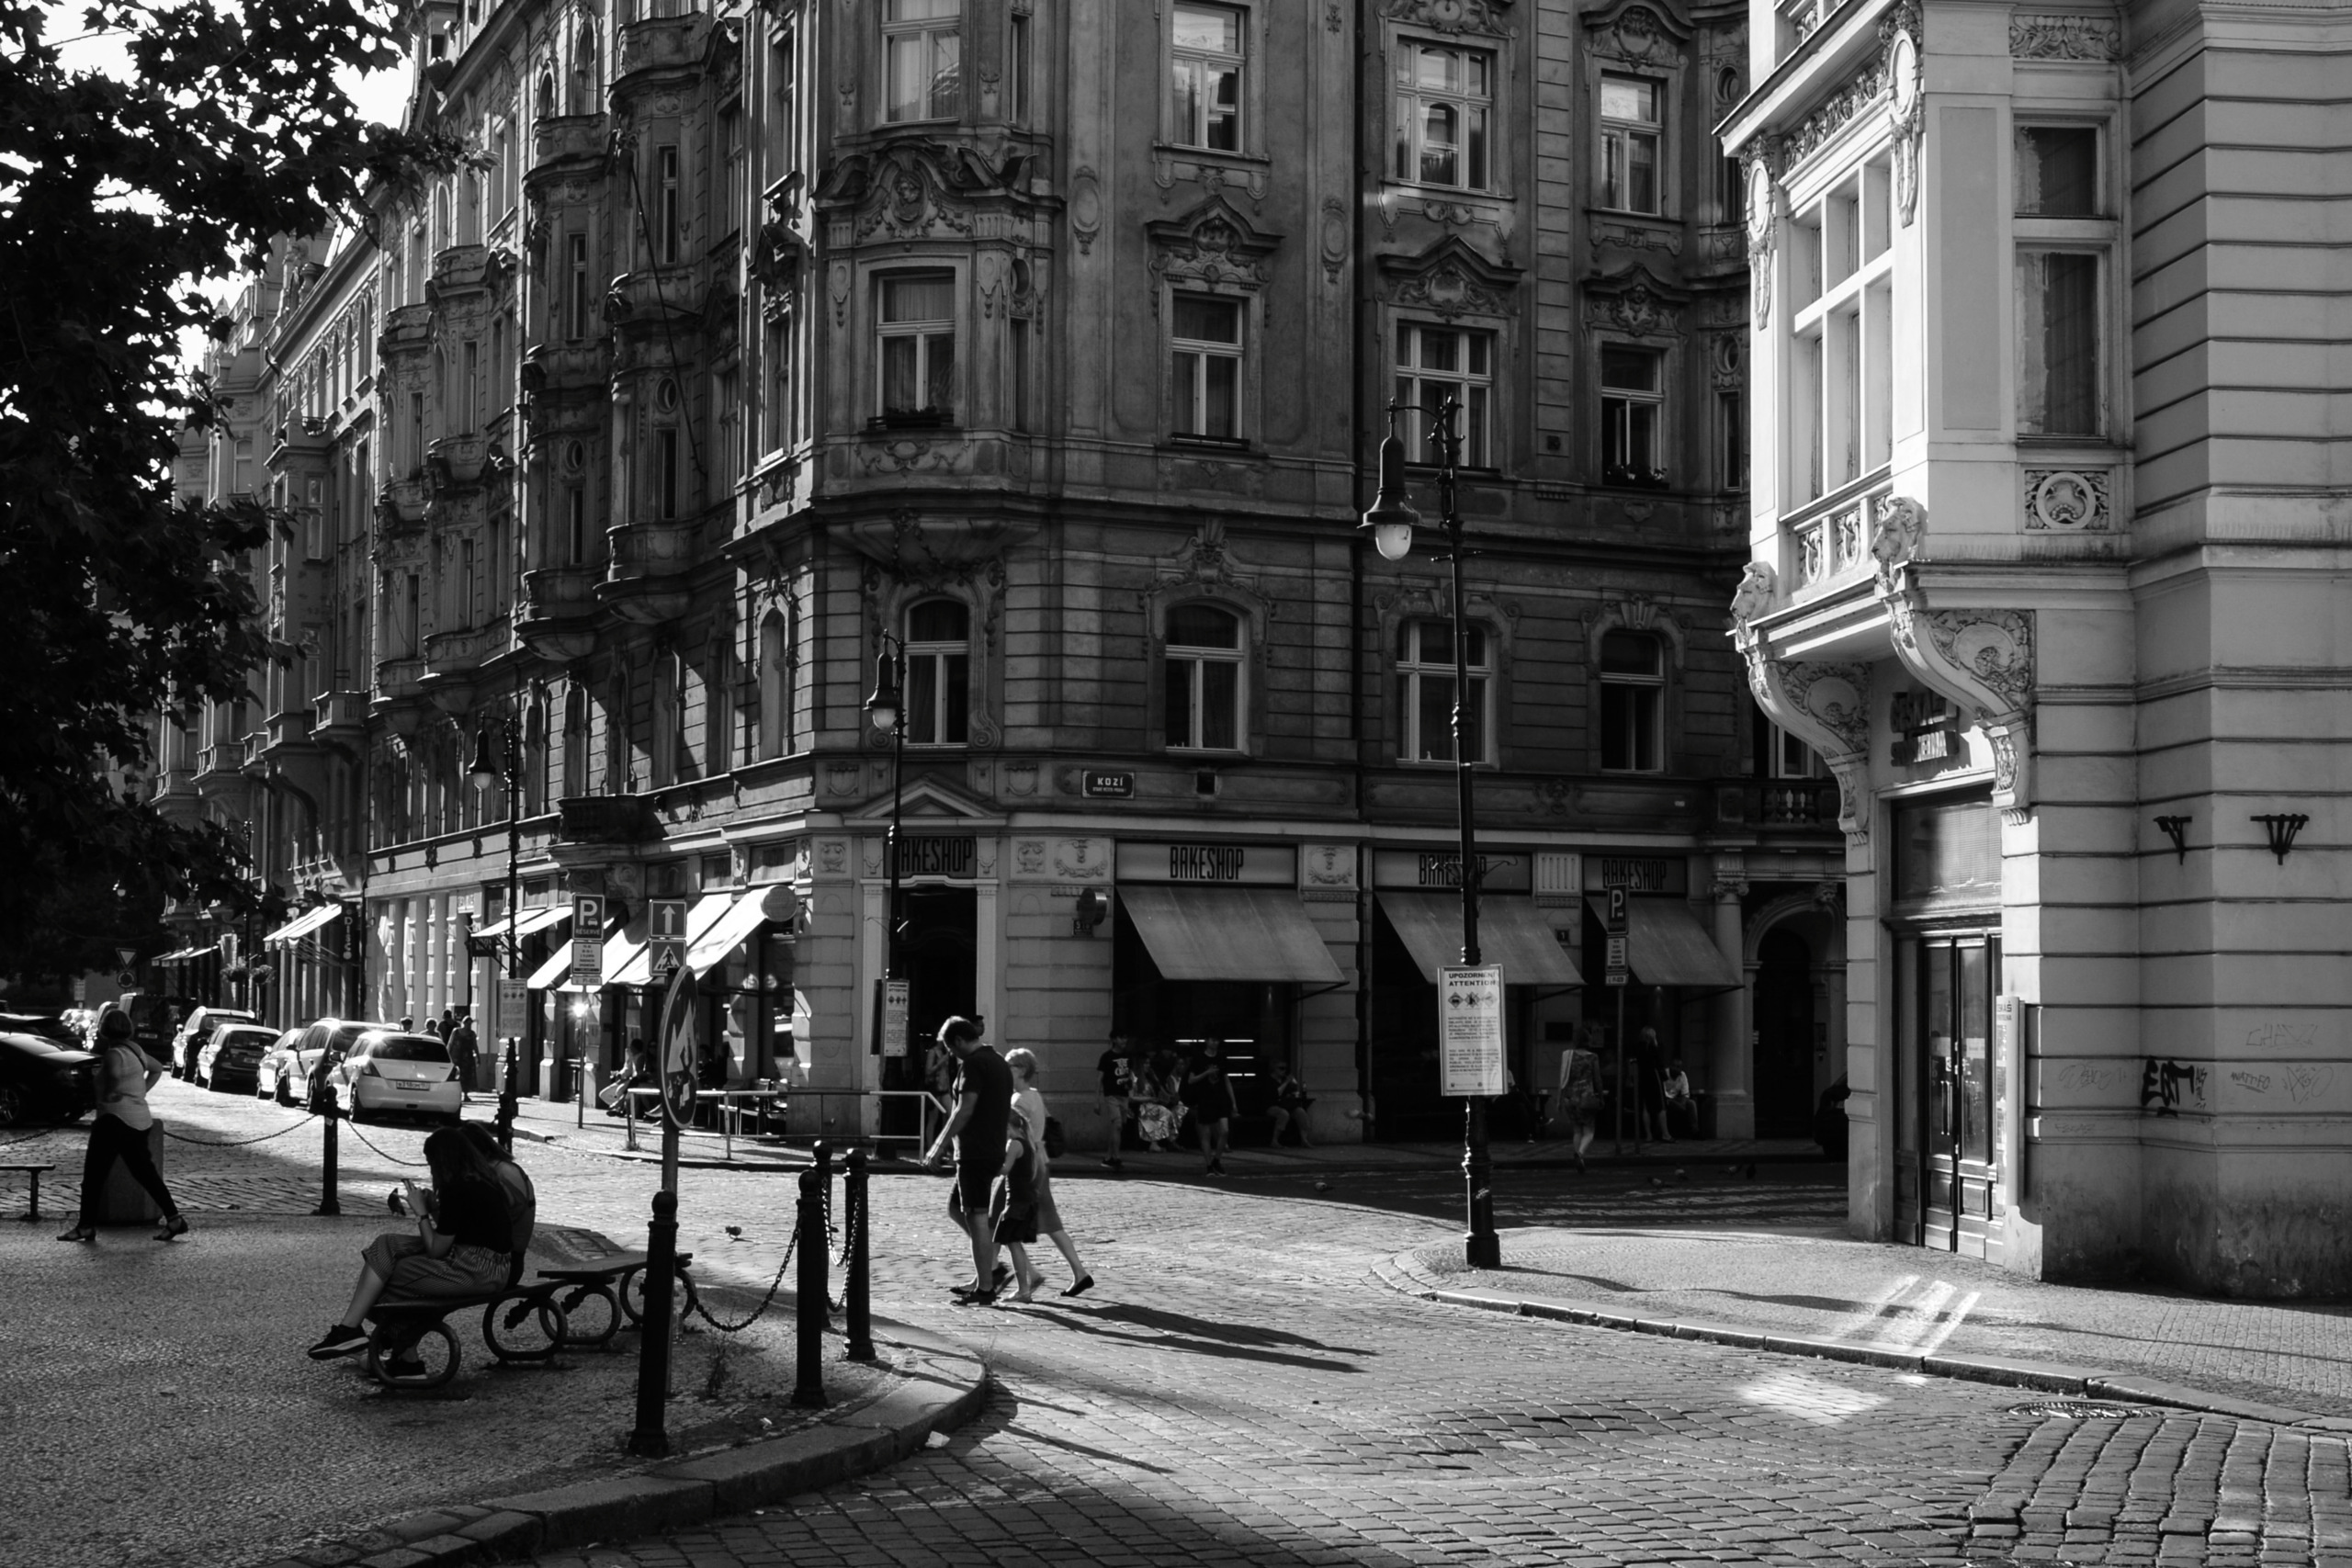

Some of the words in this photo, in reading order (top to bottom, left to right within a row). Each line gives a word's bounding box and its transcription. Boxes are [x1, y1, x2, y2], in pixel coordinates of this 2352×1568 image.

[1097, 776, 1124, 786] KOZÍ
[900, 839, 972, 872] AKESHOP
[1170, 846, 1244, 880] BAKESHOP
[1419, 854, 1487, 886] BAKESP
[579, 899, 598, 926] P
